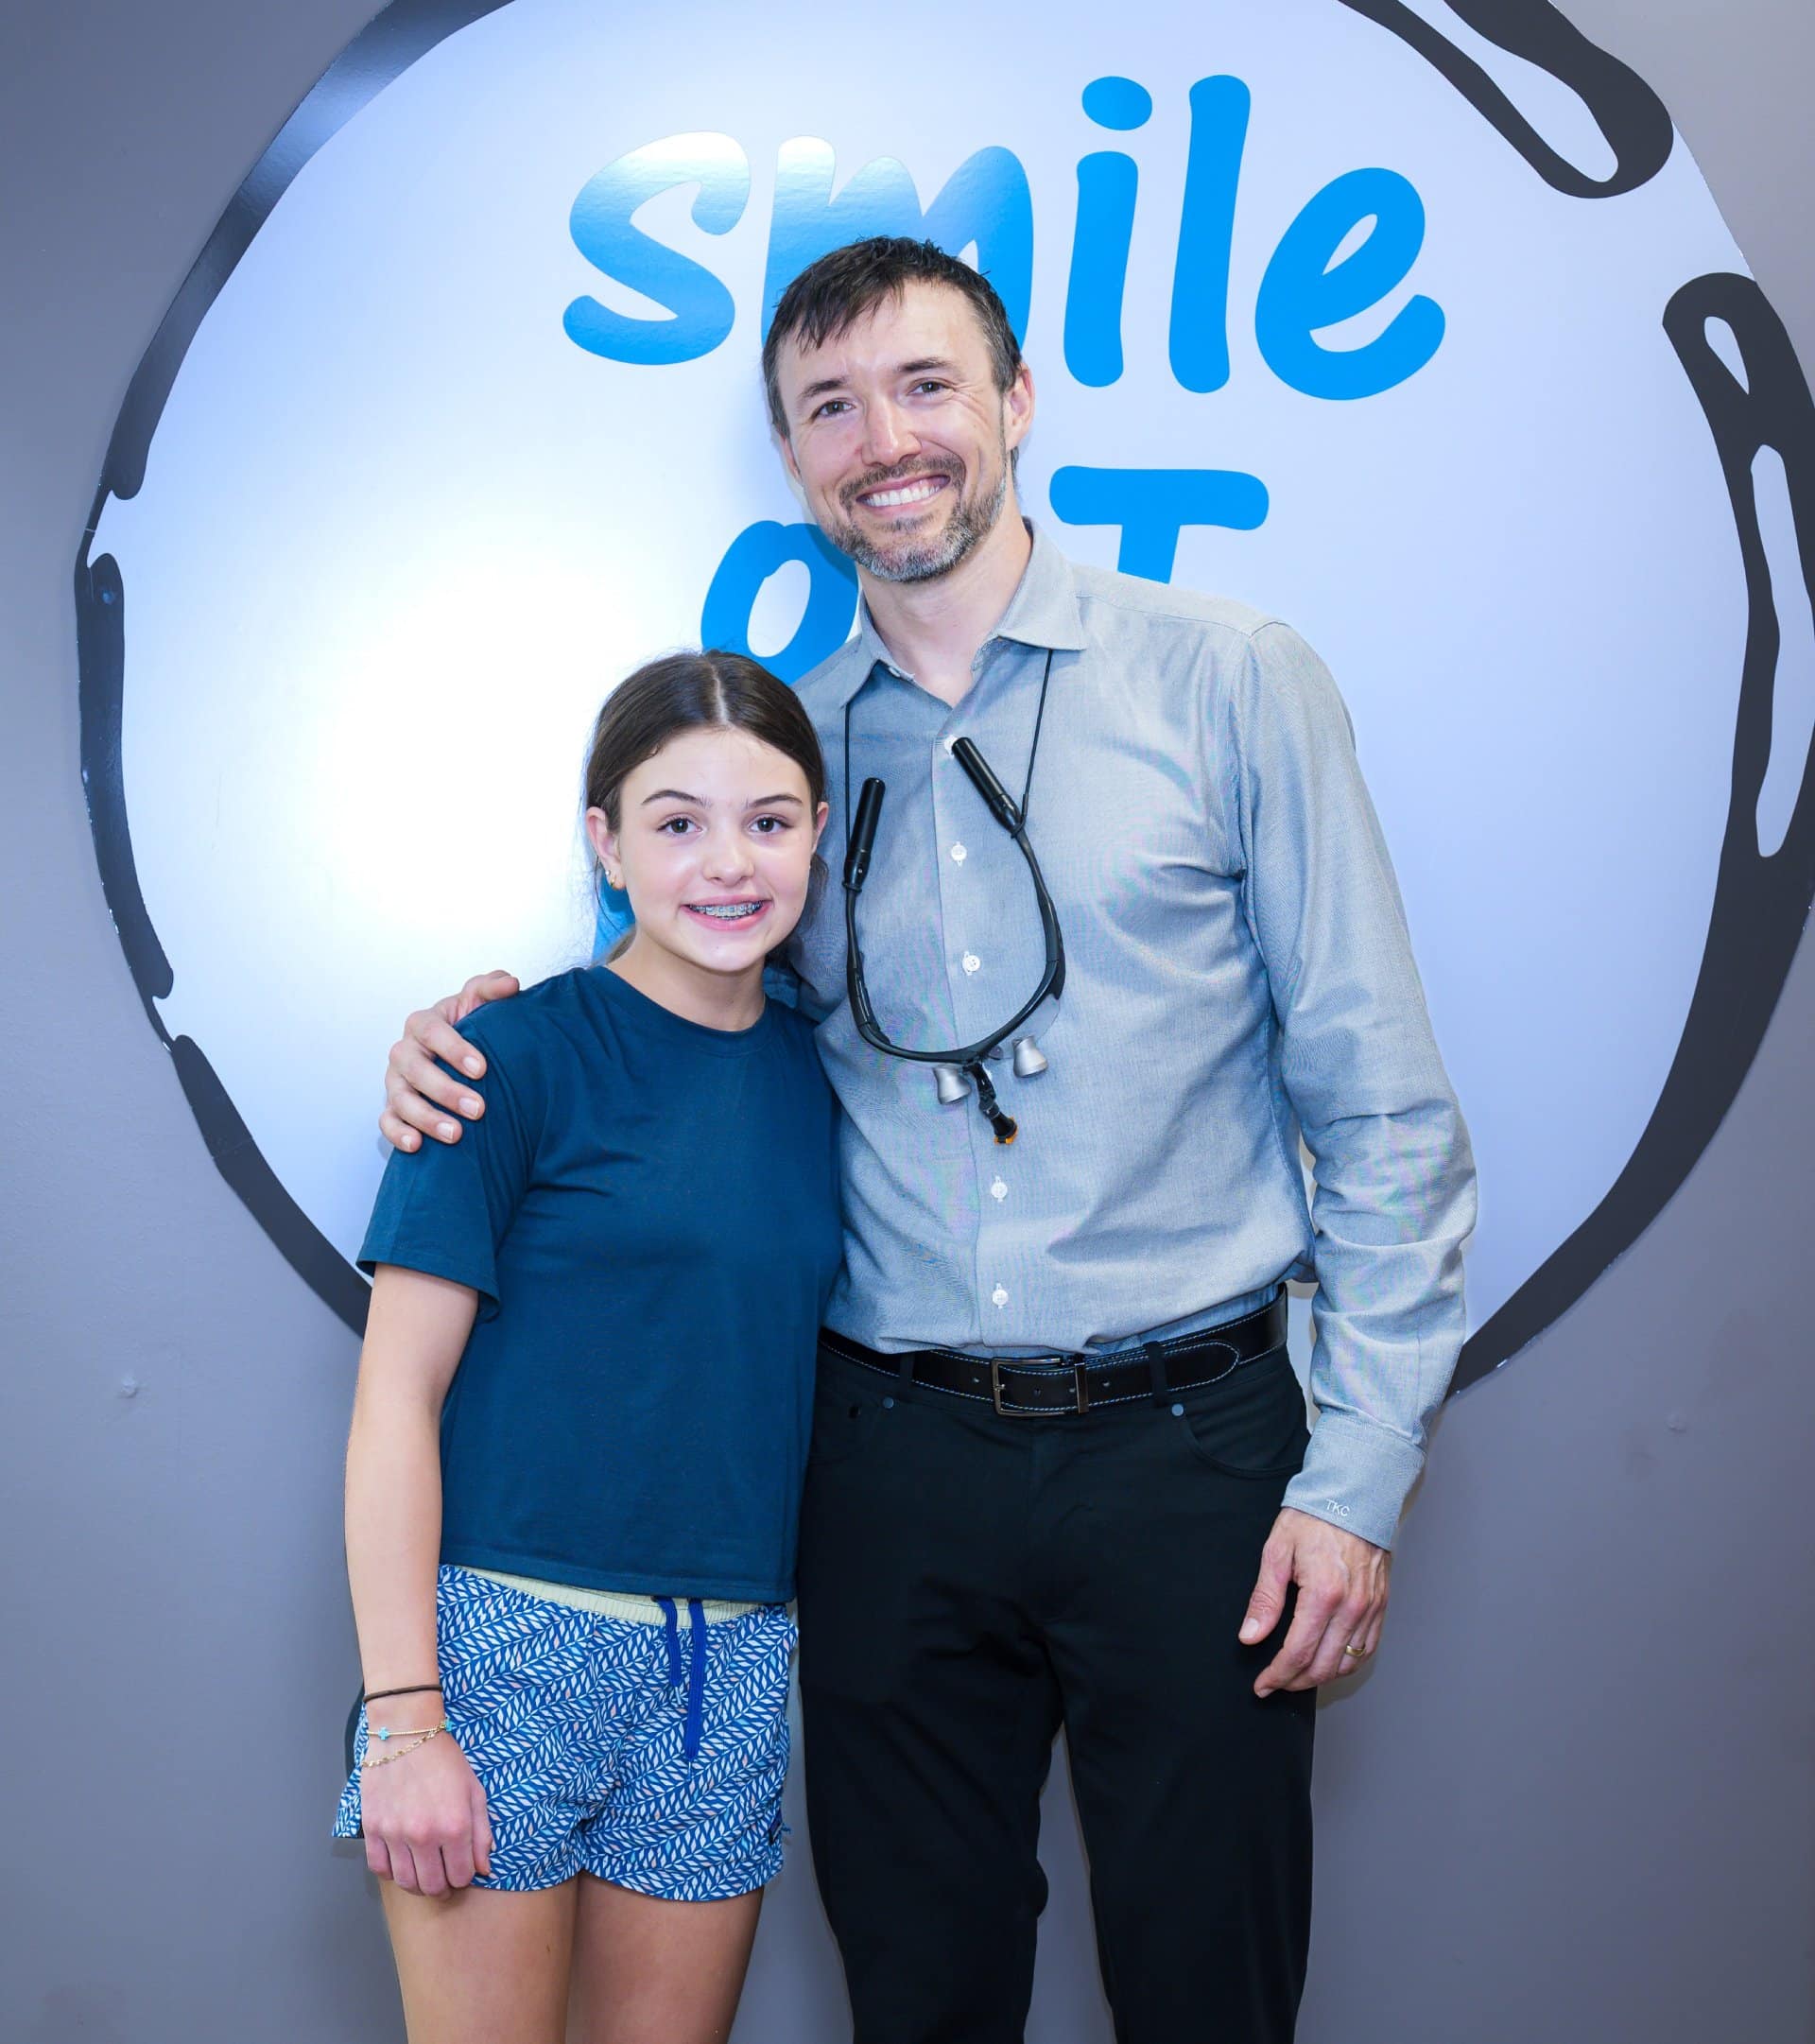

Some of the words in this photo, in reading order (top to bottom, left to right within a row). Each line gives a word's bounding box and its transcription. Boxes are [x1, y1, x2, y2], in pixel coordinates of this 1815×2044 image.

[562, 75, 1446, 401] smile
[701, 465, 1270, 684] oT
[1325, 1498, 1350, 1516] TKC
